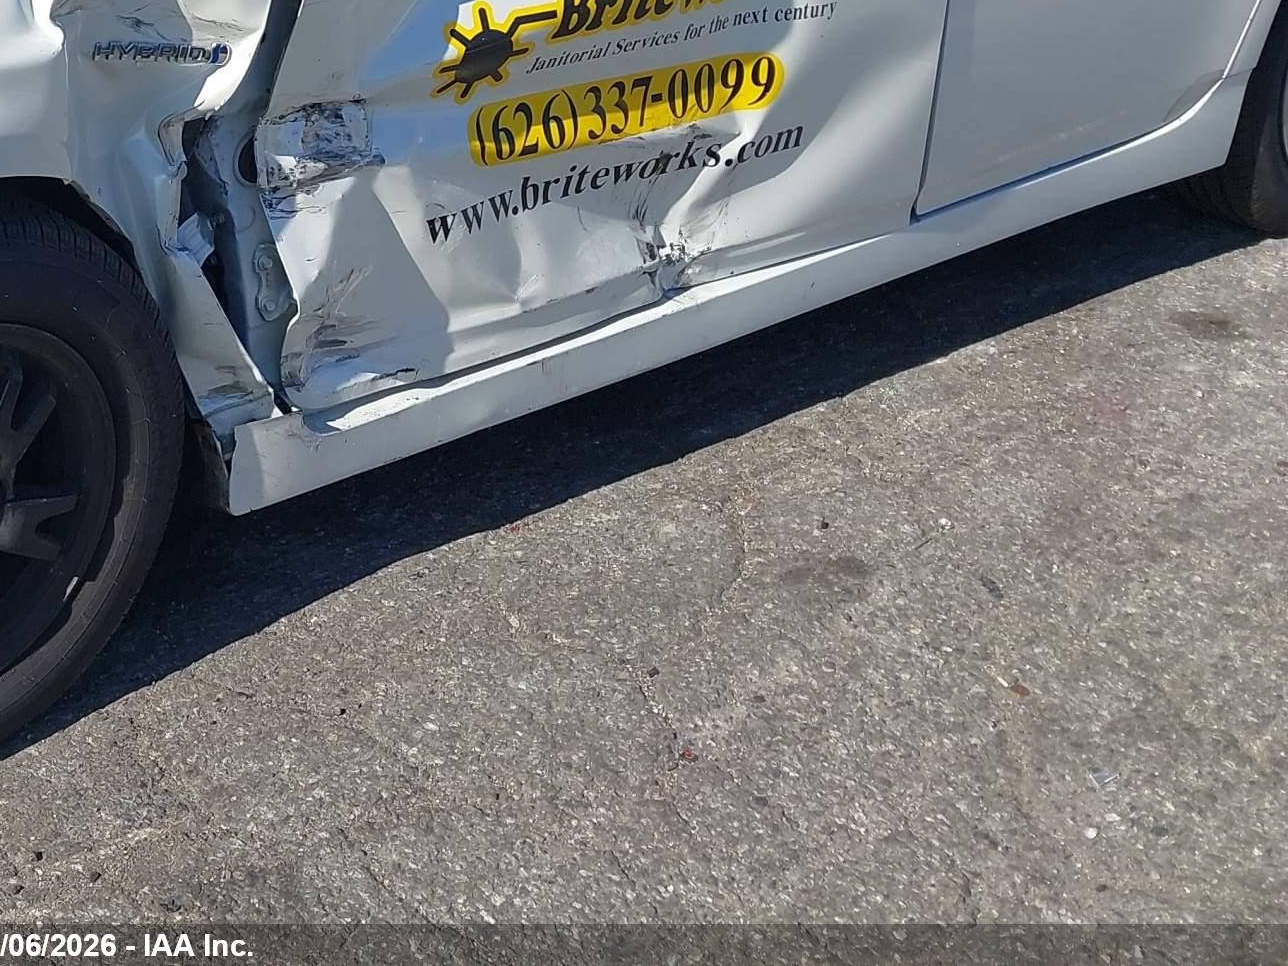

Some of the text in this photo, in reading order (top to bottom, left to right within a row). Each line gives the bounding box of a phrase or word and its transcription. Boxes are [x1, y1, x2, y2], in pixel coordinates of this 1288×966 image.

[92, 42, 211, 62] HYBRID
[526, 0, 837, 74] Janitorial Services for the next century
[426, 122, 801, 245] www.briteworks.com
